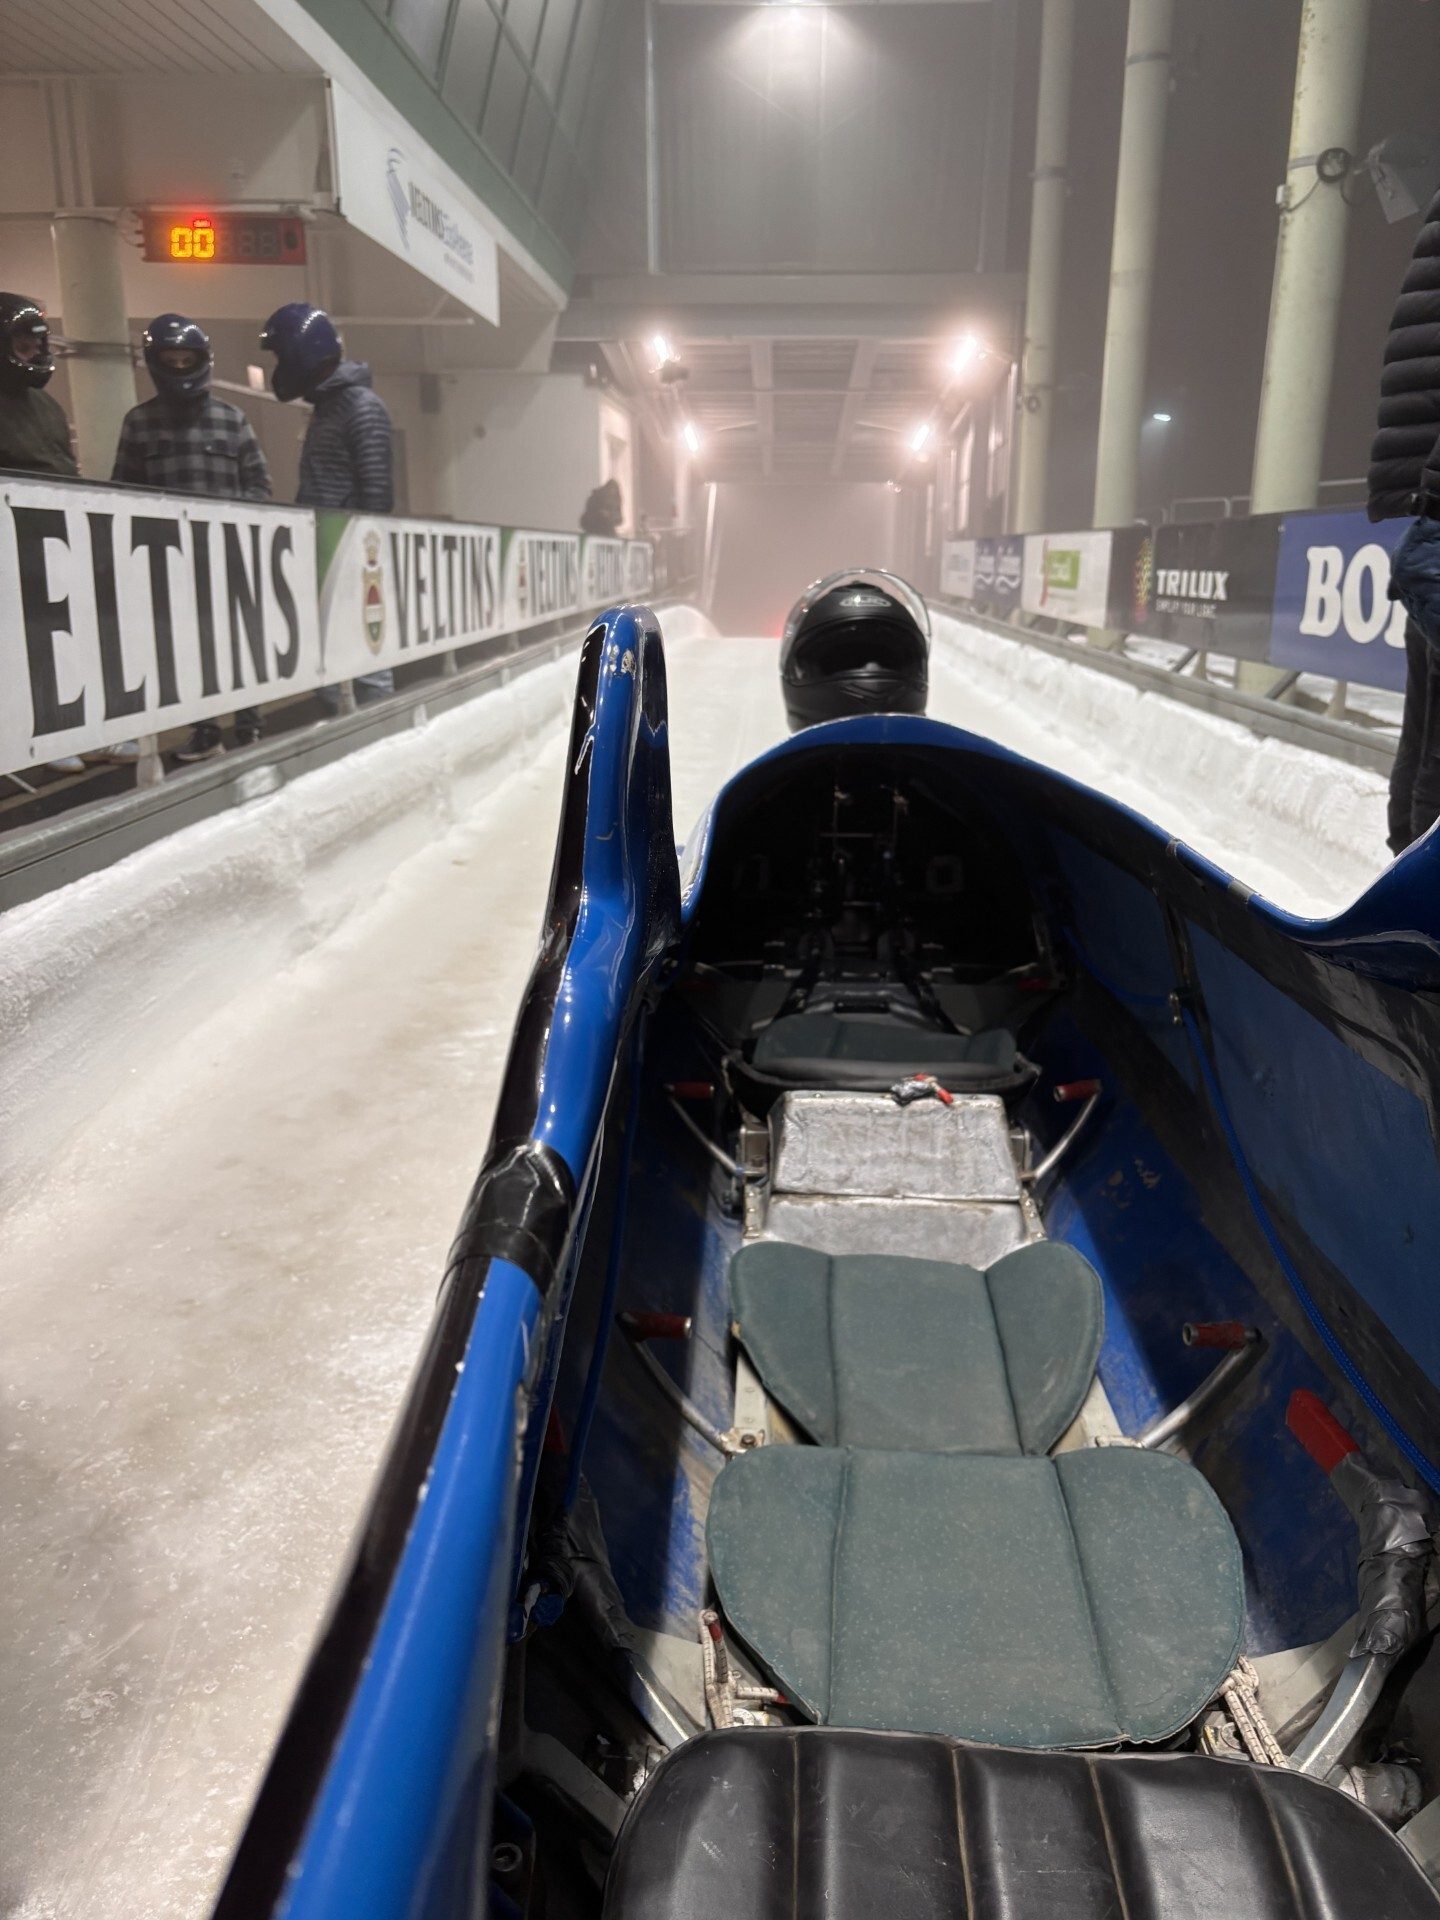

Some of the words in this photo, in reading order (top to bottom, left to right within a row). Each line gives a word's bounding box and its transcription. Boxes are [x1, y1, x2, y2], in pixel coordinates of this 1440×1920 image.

[10, 506, 300, 738] ELTINS
[389, 532, 494, 649] VELTINS
[528, 539, 577, 618] VELTINS
[1156, 569, 1229, 600] TRILUX
